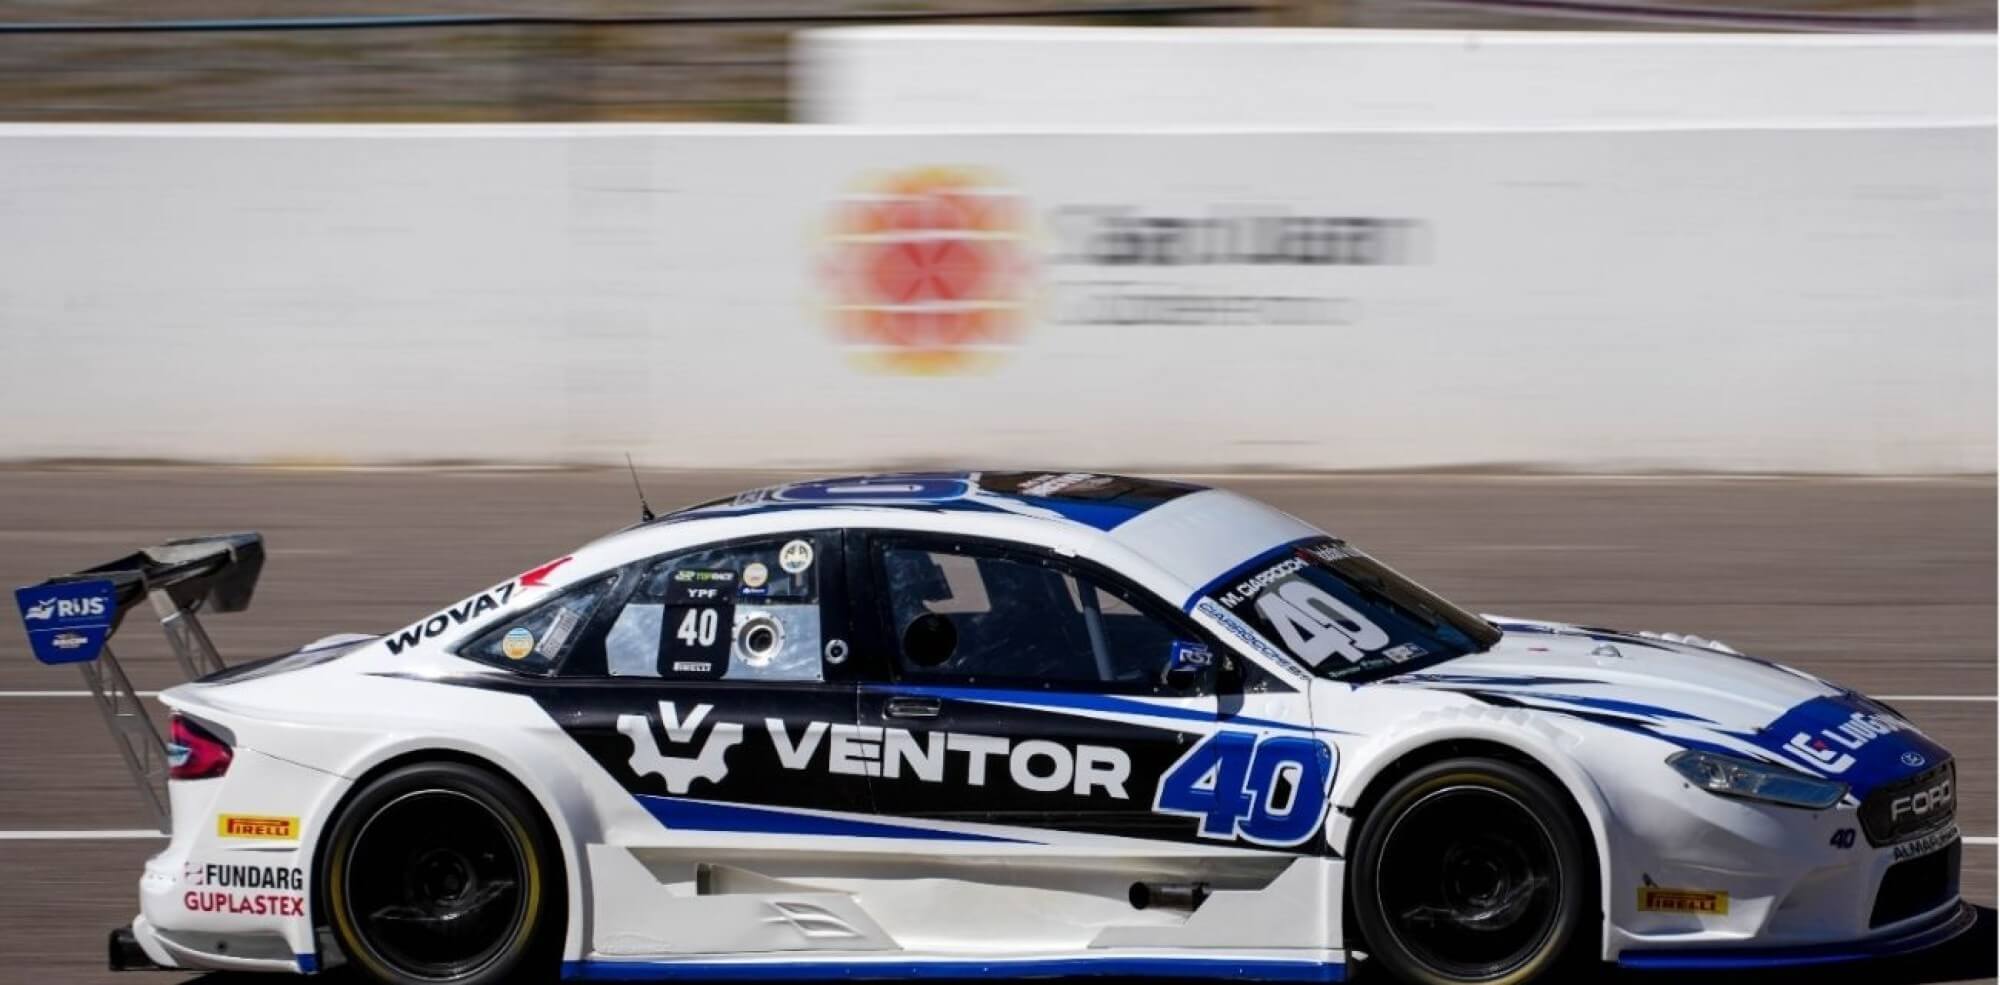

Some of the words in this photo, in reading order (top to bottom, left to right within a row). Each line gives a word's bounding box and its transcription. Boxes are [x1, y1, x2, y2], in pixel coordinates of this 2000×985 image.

[688, 588, 717, 598] YPF
[677, 608, 718, 646] 40
[1254, 578, 1390, 668] 40
[673, 661, 712, 672] PIRELLI
[765, 718, 1131, 799] VENTOR
[1151, 729, 1339, 848] 40
[1890, 780, 1951, 822] FORD
[226, 818, 290, 836] PIRELLI
[1829, 828, 1857, 849] 40
[206, 864, 304, 891] FUNDARG
[184, 891, 304, 917] GUPLASTEX
[1646, 890, 1718, 912] PIRELLI
